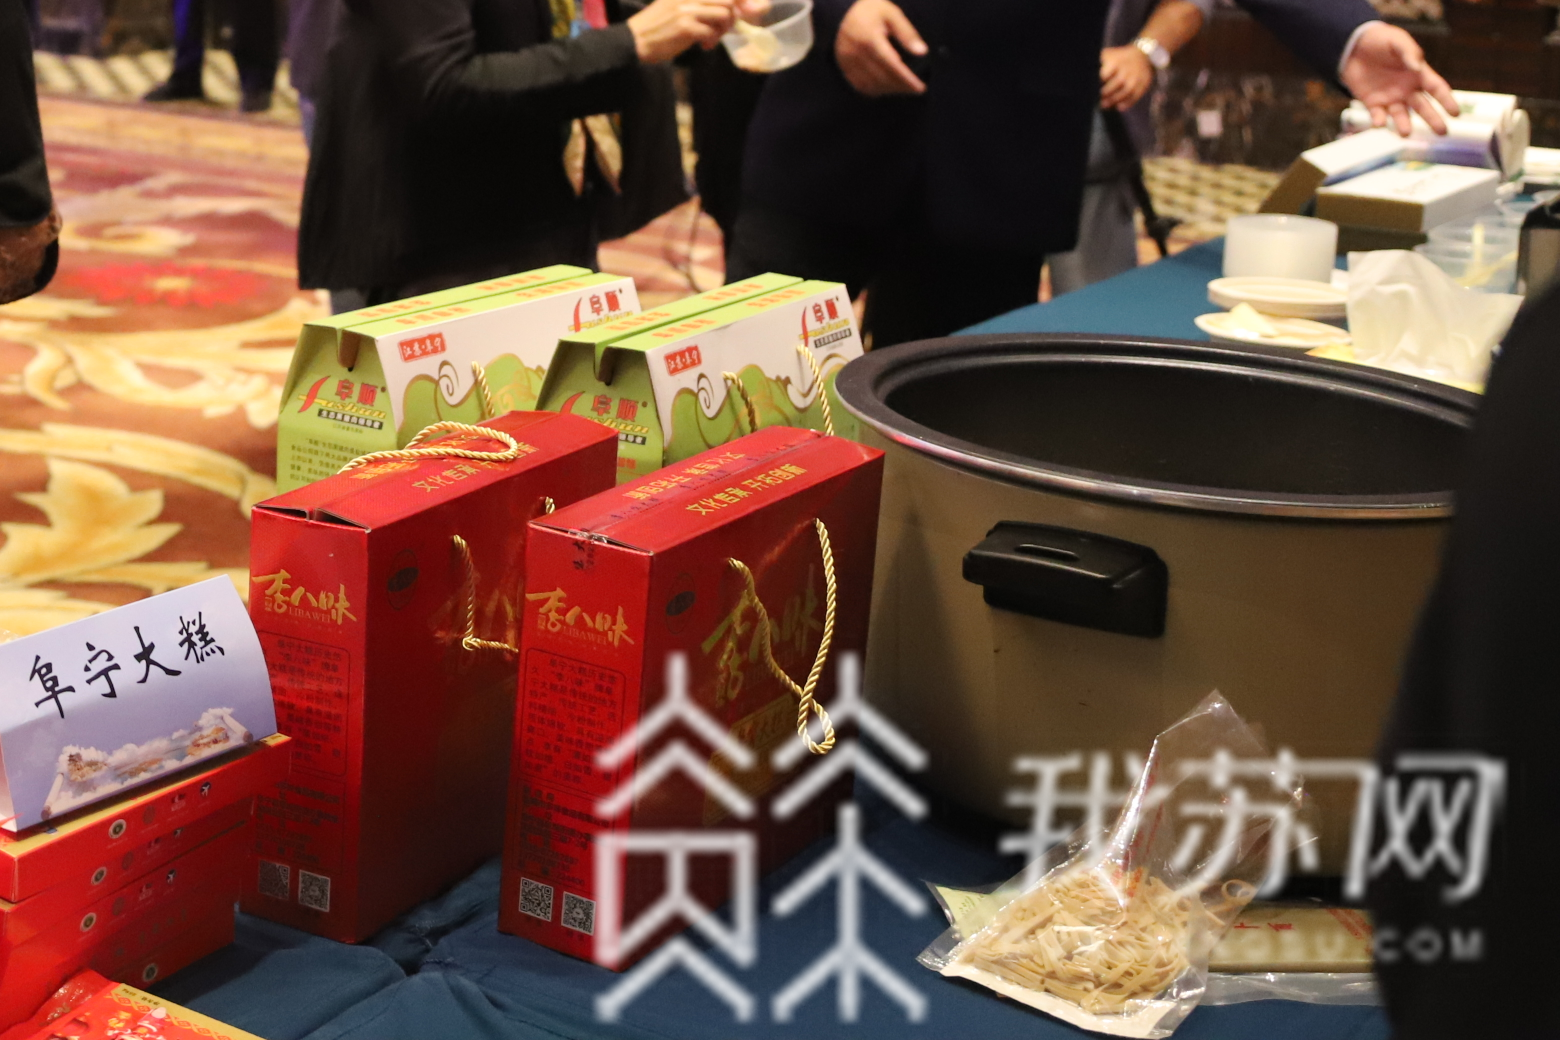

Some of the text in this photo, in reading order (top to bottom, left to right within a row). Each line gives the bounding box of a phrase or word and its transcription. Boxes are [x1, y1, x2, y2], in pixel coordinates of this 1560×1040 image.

[589, 290, 621, 316] 阜顺
[812, 298, 840, 324] 阜顺
[335, 379, 378, 406] 阜顺
[591, 394, 639, 422] 阜顺
[412, 462, 482, 493] 文化传承
[686, 486, 753, 516] 文化传承
[741, 463, 808, 492] 开拓创新
[252, 569, 357, 625] 李八味
[289, 606, 331, 624] LIBAWEI
[525, 587, 634, 648] 李八味
[563, 625, 607, 646] LIBAWEI
[29, 611, 225, 719] 阜宁大糕
